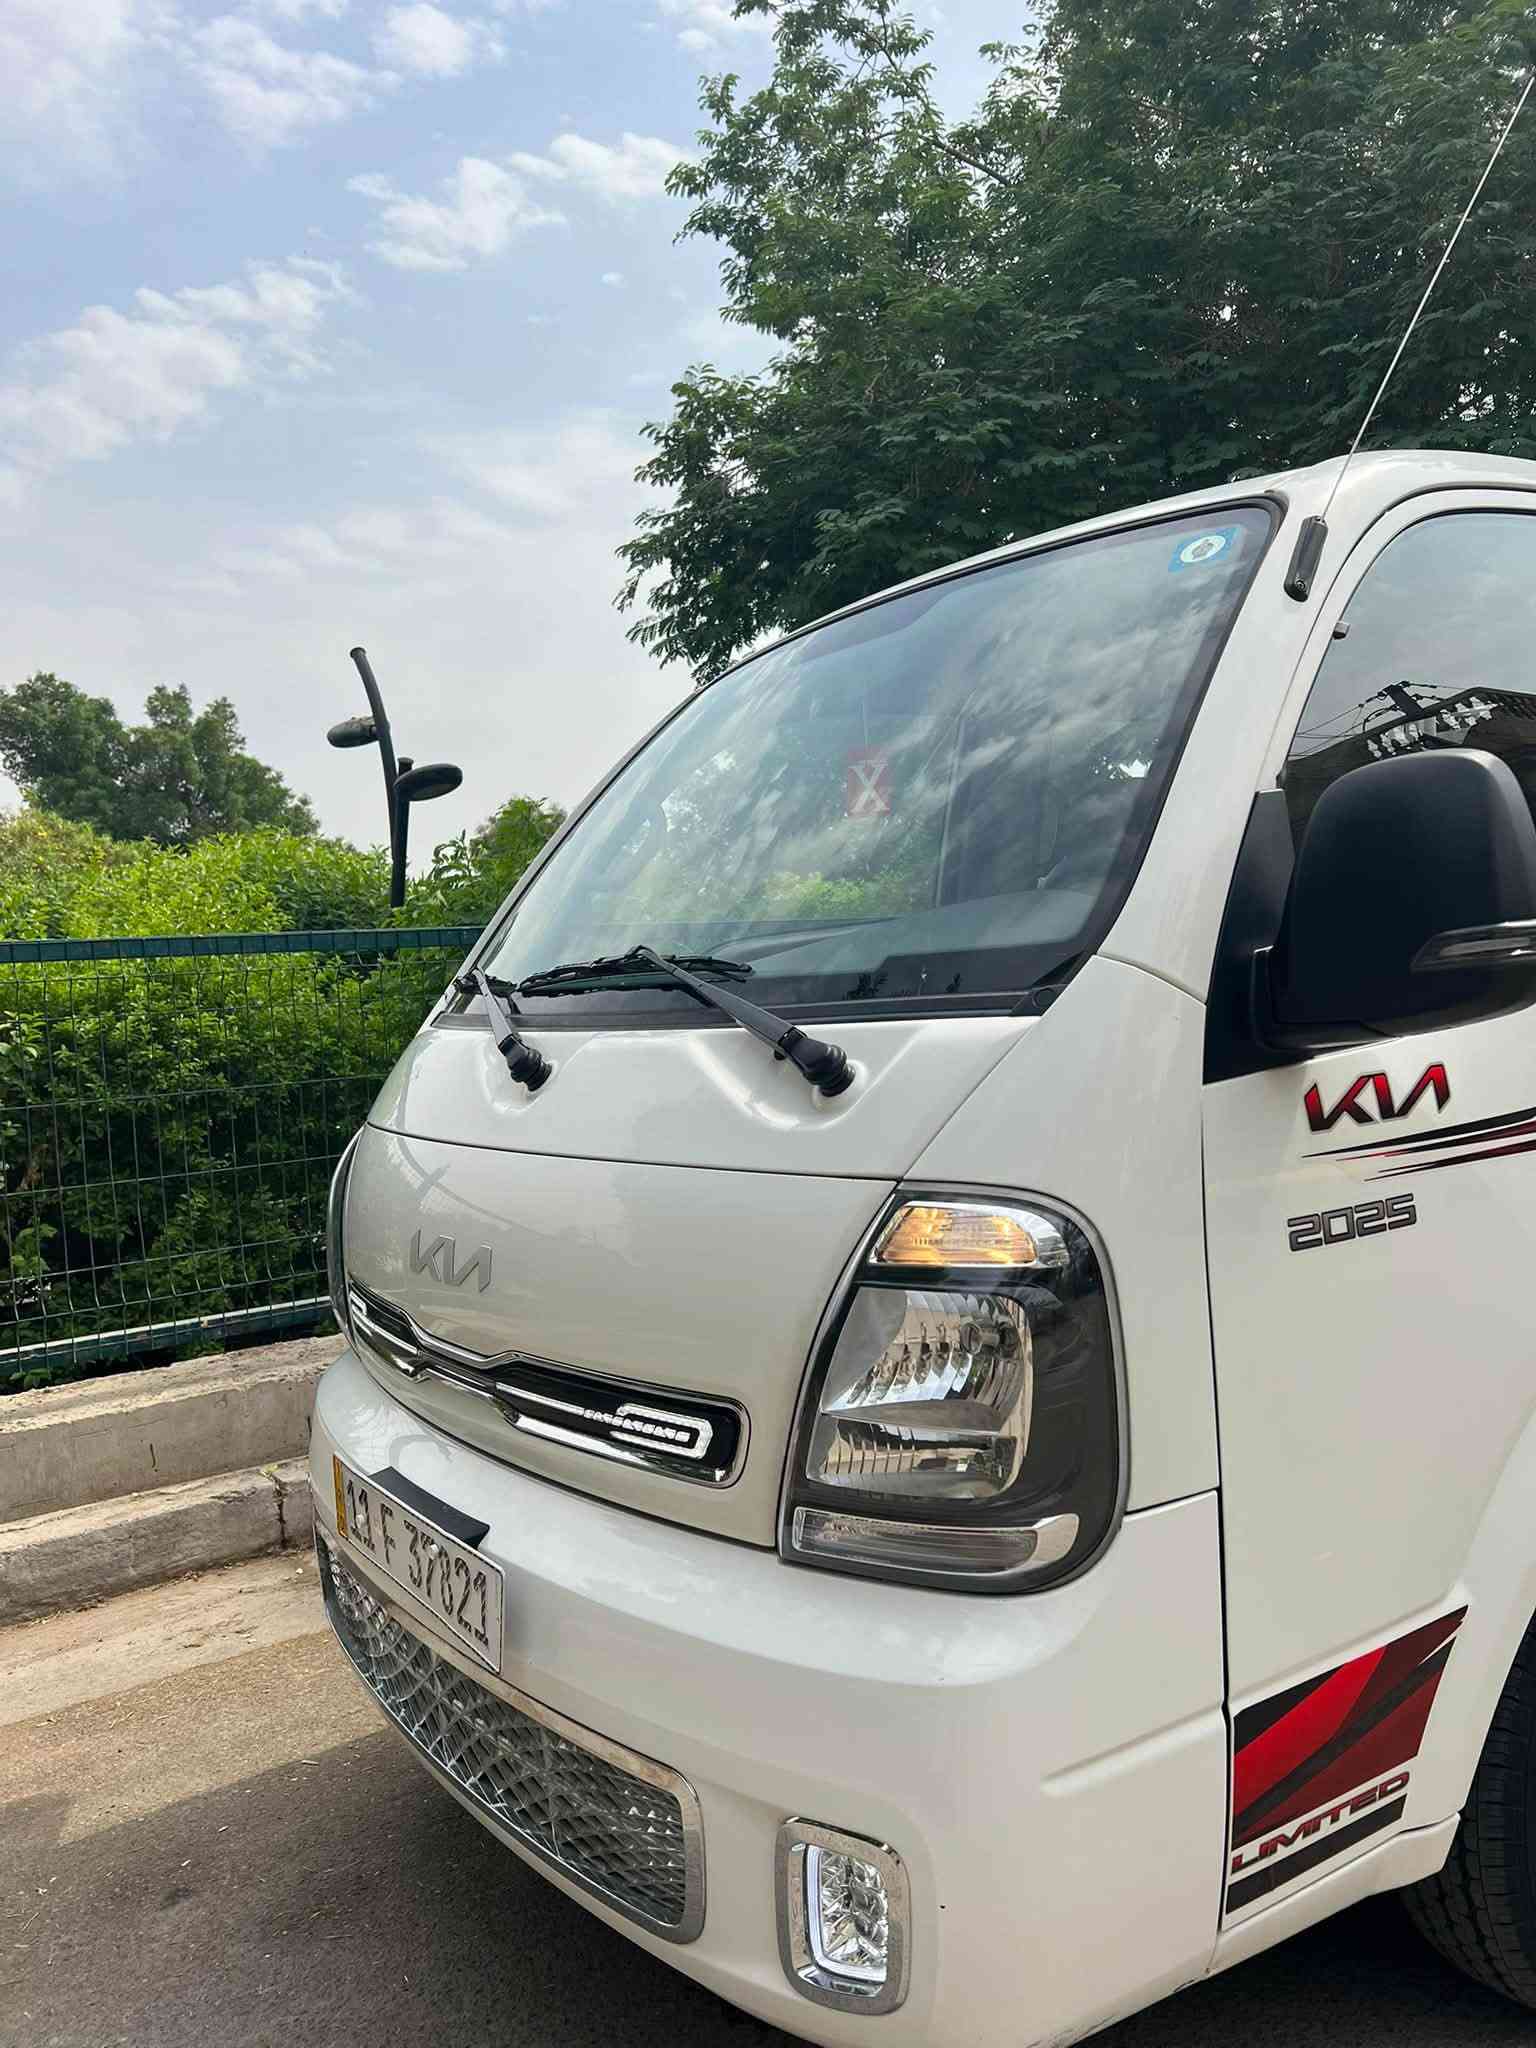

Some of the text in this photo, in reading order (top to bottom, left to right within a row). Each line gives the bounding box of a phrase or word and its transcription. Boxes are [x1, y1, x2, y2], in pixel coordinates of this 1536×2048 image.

[1303, 1062, 1451, 1133] KIA
[1287, 1193, 1417, 1252] 2025
[409, 1228, 493, 1294] KIA
[380, 1503, 396, 1565] F
[403, 1519, 489, 1648] 37821
[1231, 1770, 1411, 1876] LIMITED
